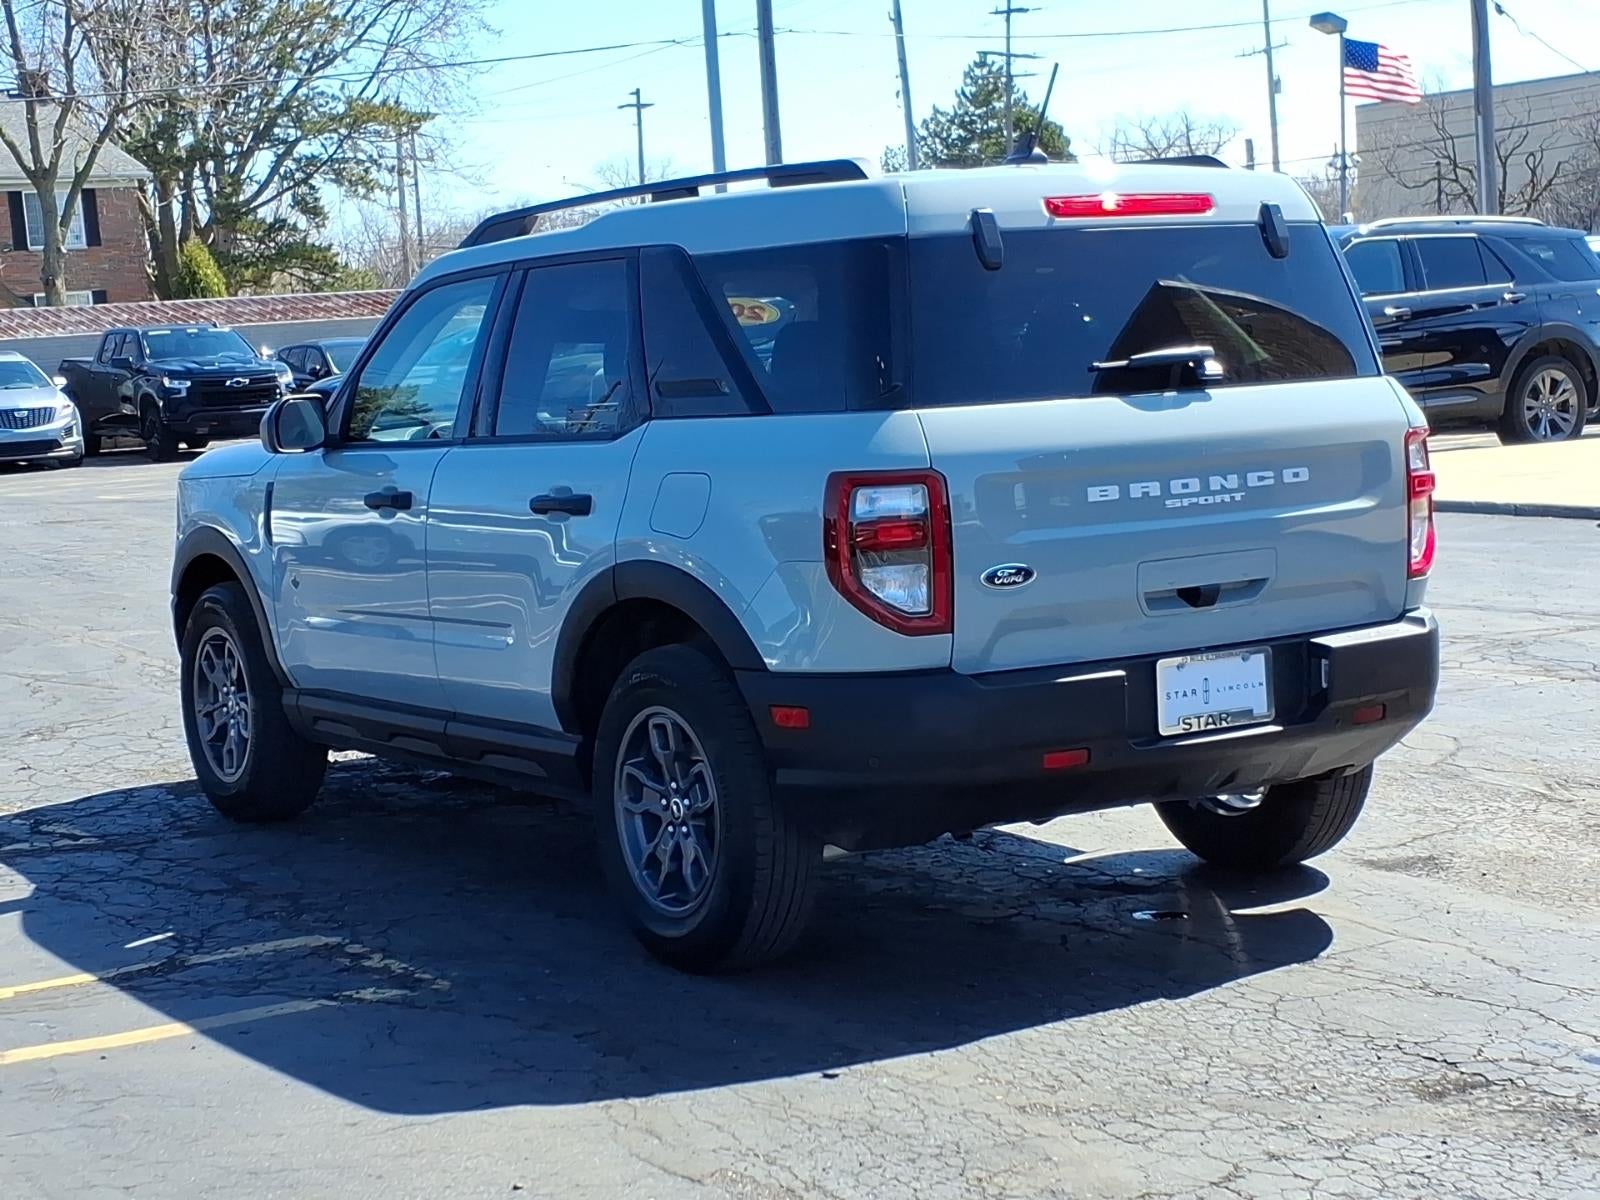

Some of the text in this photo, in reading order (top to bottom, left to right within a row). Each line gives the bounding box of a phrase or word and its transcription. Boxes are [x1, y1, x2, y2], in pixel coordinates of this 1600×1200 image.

[1087, 467, 1310, 502] BRONCO
[1164, 492, 1246, 508] SPORT
[994, 569, 1025, 585] Ford
[1165, 681, 1264, 701] STAR LINCOLN
[1181, 712, 1231, 731] STAR
